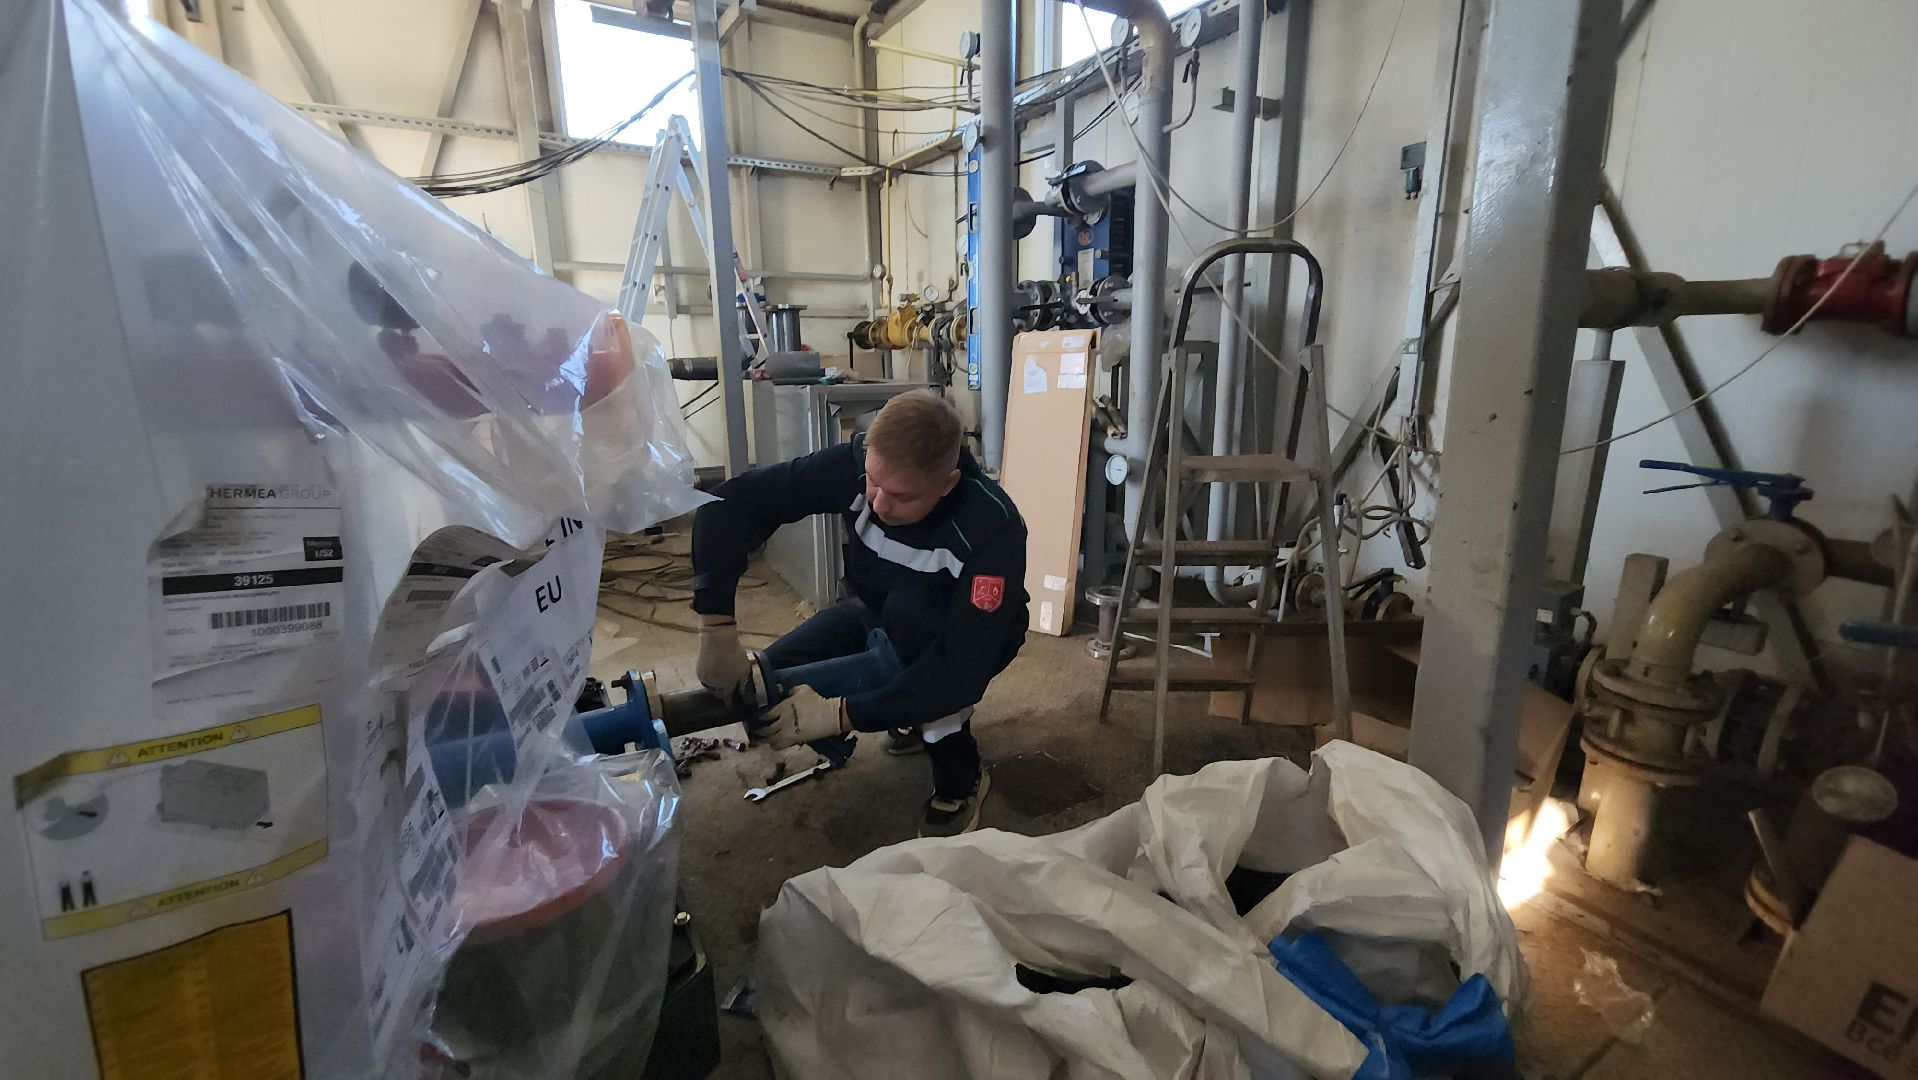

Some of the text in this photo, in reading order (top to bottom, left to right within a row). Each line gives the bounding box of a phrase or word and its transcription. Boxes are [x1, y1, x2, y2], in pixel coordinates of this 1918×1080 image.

[208, 487, 332, 499] HERMEA GROUP
[315, 548, 335, 559] 1/52
[233, 573, 275, 588] 39125
[535, 575, 562, 614] EU
[137, 732, 224, 759] ATTENTION
[156, 878, 240, 909] ATTENTION
